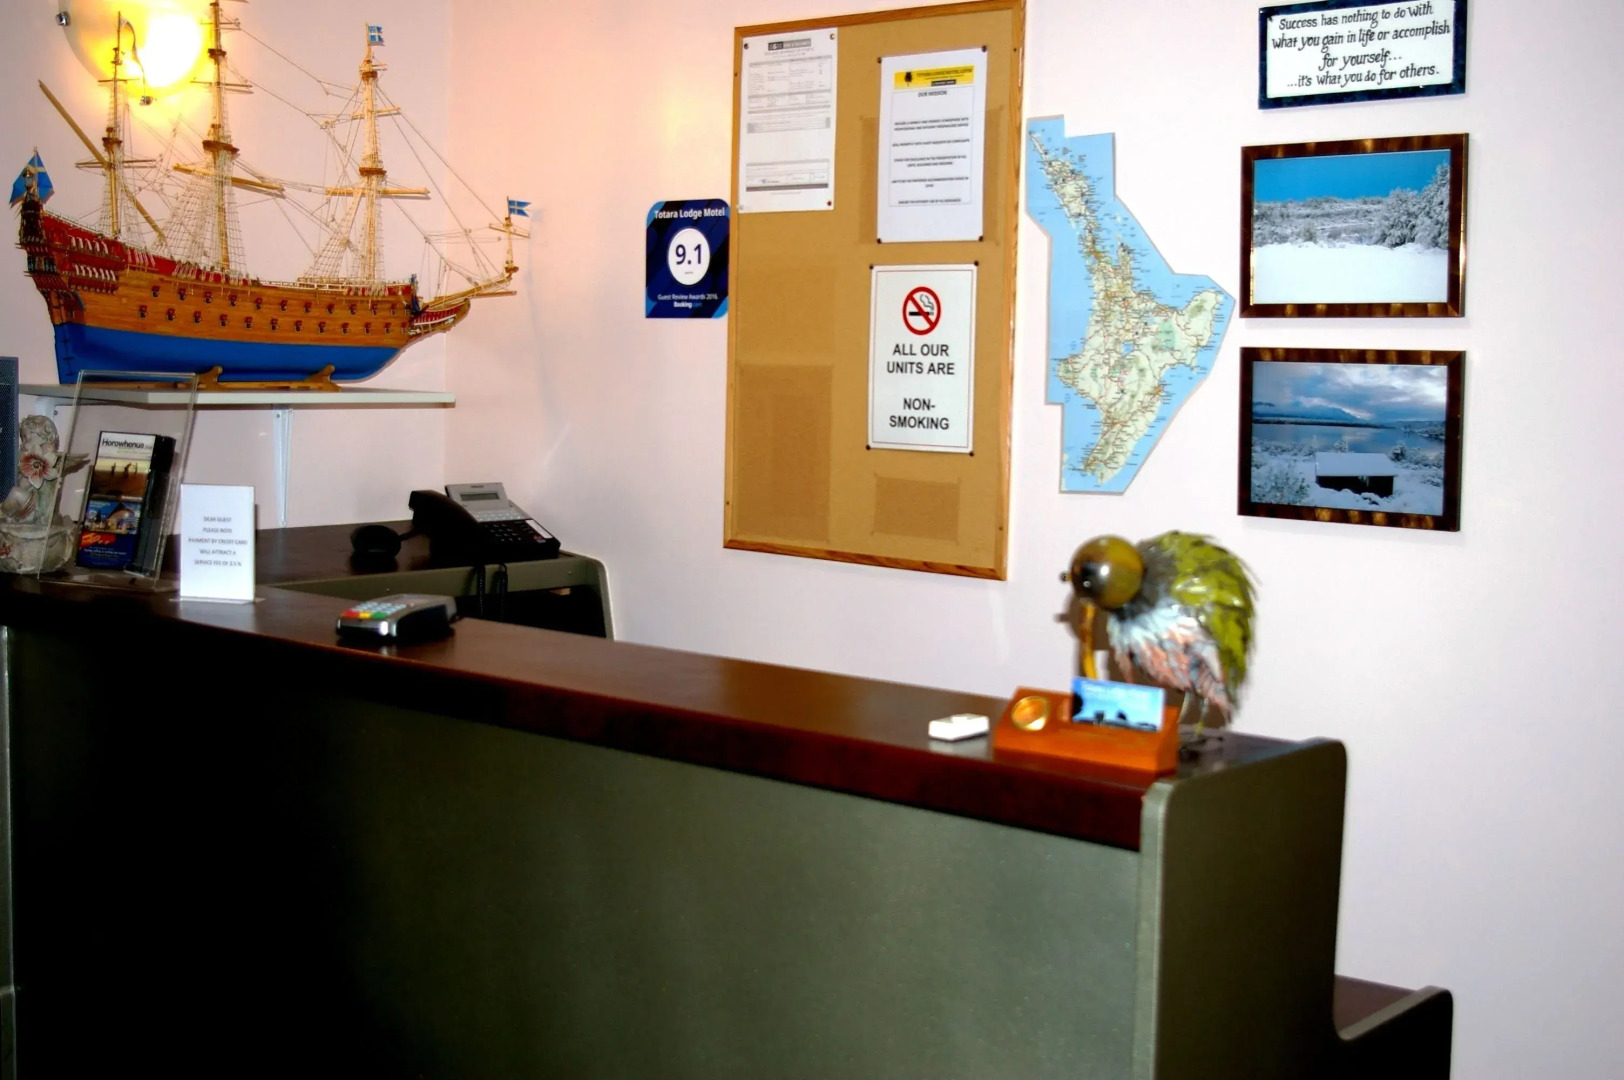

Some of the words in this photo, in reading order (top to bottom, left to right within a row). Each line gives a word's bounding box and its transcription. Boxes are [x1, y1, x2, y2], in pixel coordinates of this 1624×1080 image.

[1279, 19, 1318, 30] Success
[1321, 14, 1338, 26] has
[1342, 9, 1378, 28] nothing
[1382, 9, 1390, 20] to
[1394, 7, 1406, 20] do
[1298, 36, 1320, 51] you
[1321, 32, 1344, 53] gain
[1346, 30, 1356, 44] in
[1358, 28, 1375, 48] life
[1377, 31, 1390, 41] or
[1392, 20, 1450, 40] accomplish
[1318, 52, 1338, 72] for
[1342, 72, 1362, 88] you
[1364, 70, 1376, 82] do
[1377, 70, 1397, 86] for
[1400, 63, 1440, 80] others.
[654, 210, 678, 219] Totara
[680, 209, 702, 220] Lodge
[704, 208, 725, 218] Motel
[675, 244, 702, 266] 9.1
[892, 344, 917, 356] ALL
[920, 344, 950, 356] OUR
[886, 361, 924, 374] UNITS
[927, 362, 955, 375] ARE
[903, 398, 936, 410] NON-
[889, 415, 950, 430] SMOKING
